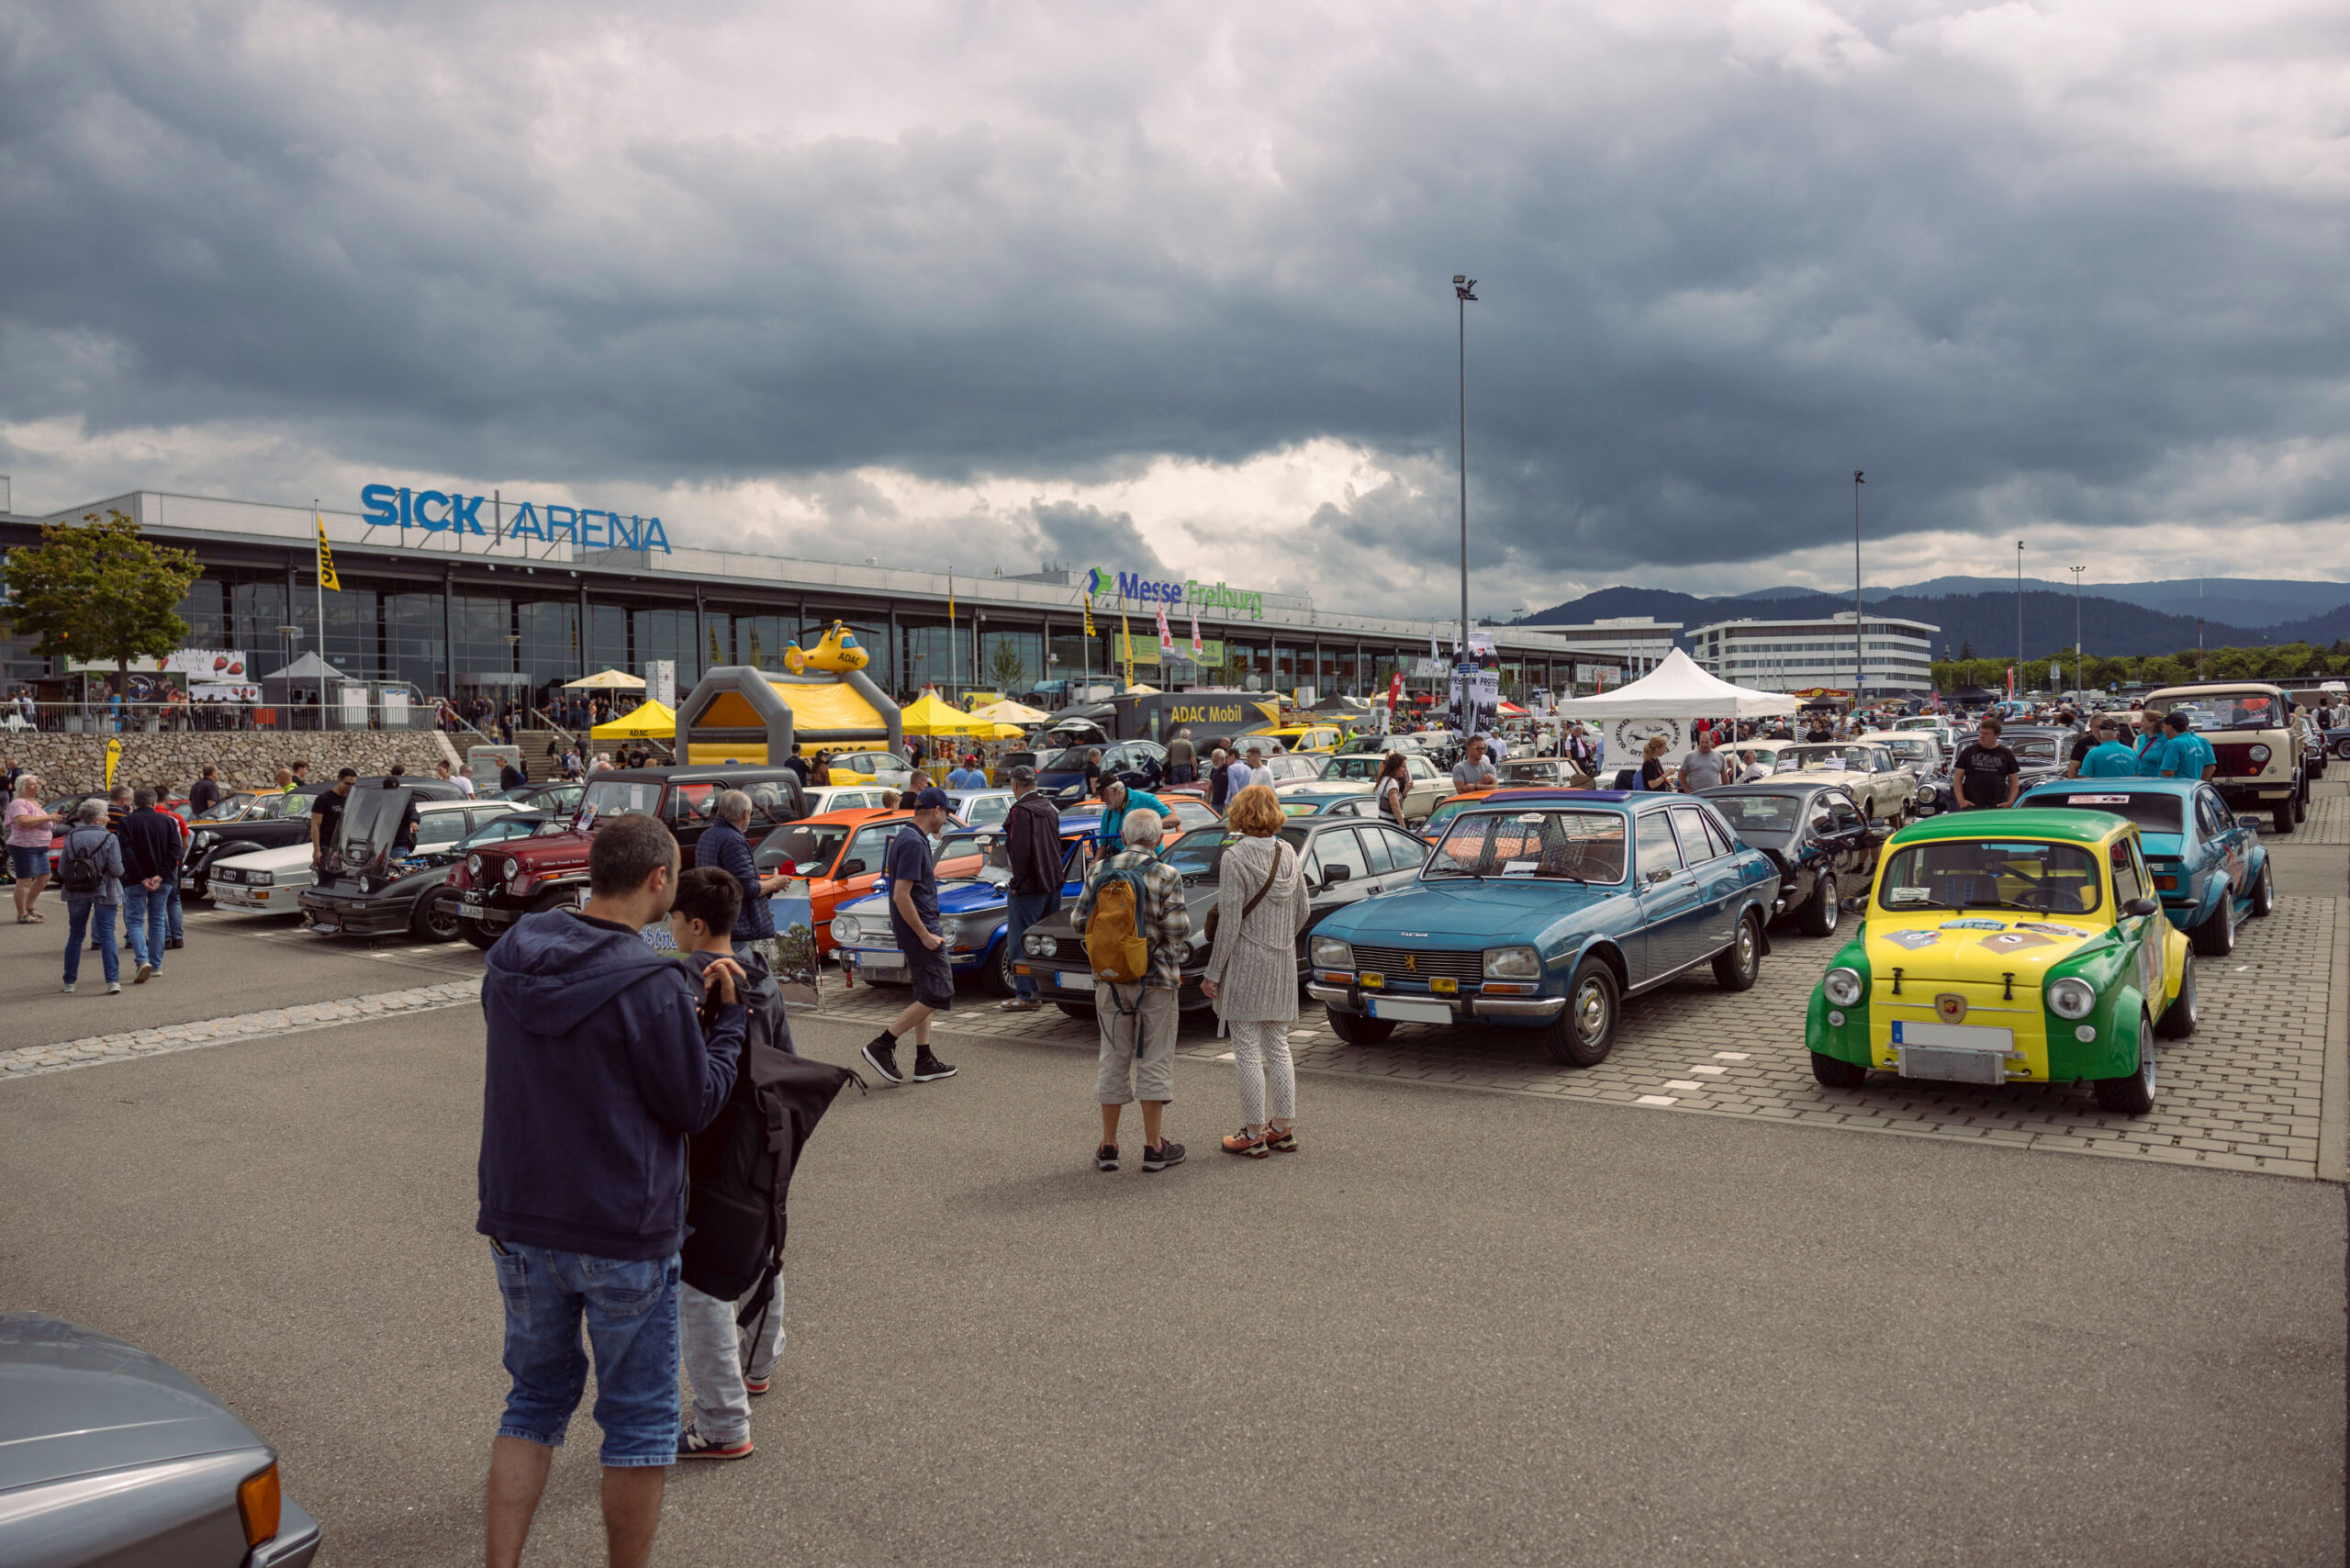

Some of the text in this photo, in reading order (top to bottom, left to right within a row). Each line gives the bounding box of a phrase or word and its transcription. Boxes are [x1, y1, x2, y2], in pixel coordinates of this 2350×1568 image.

[361, 484, 672, 554] SICK ARENA
[1119, 571, 1262, 618] Messe Freiburg
[838, 653, 860, 666] ADAC
[1170, 704, 1242, 722] ADAC Mobil
